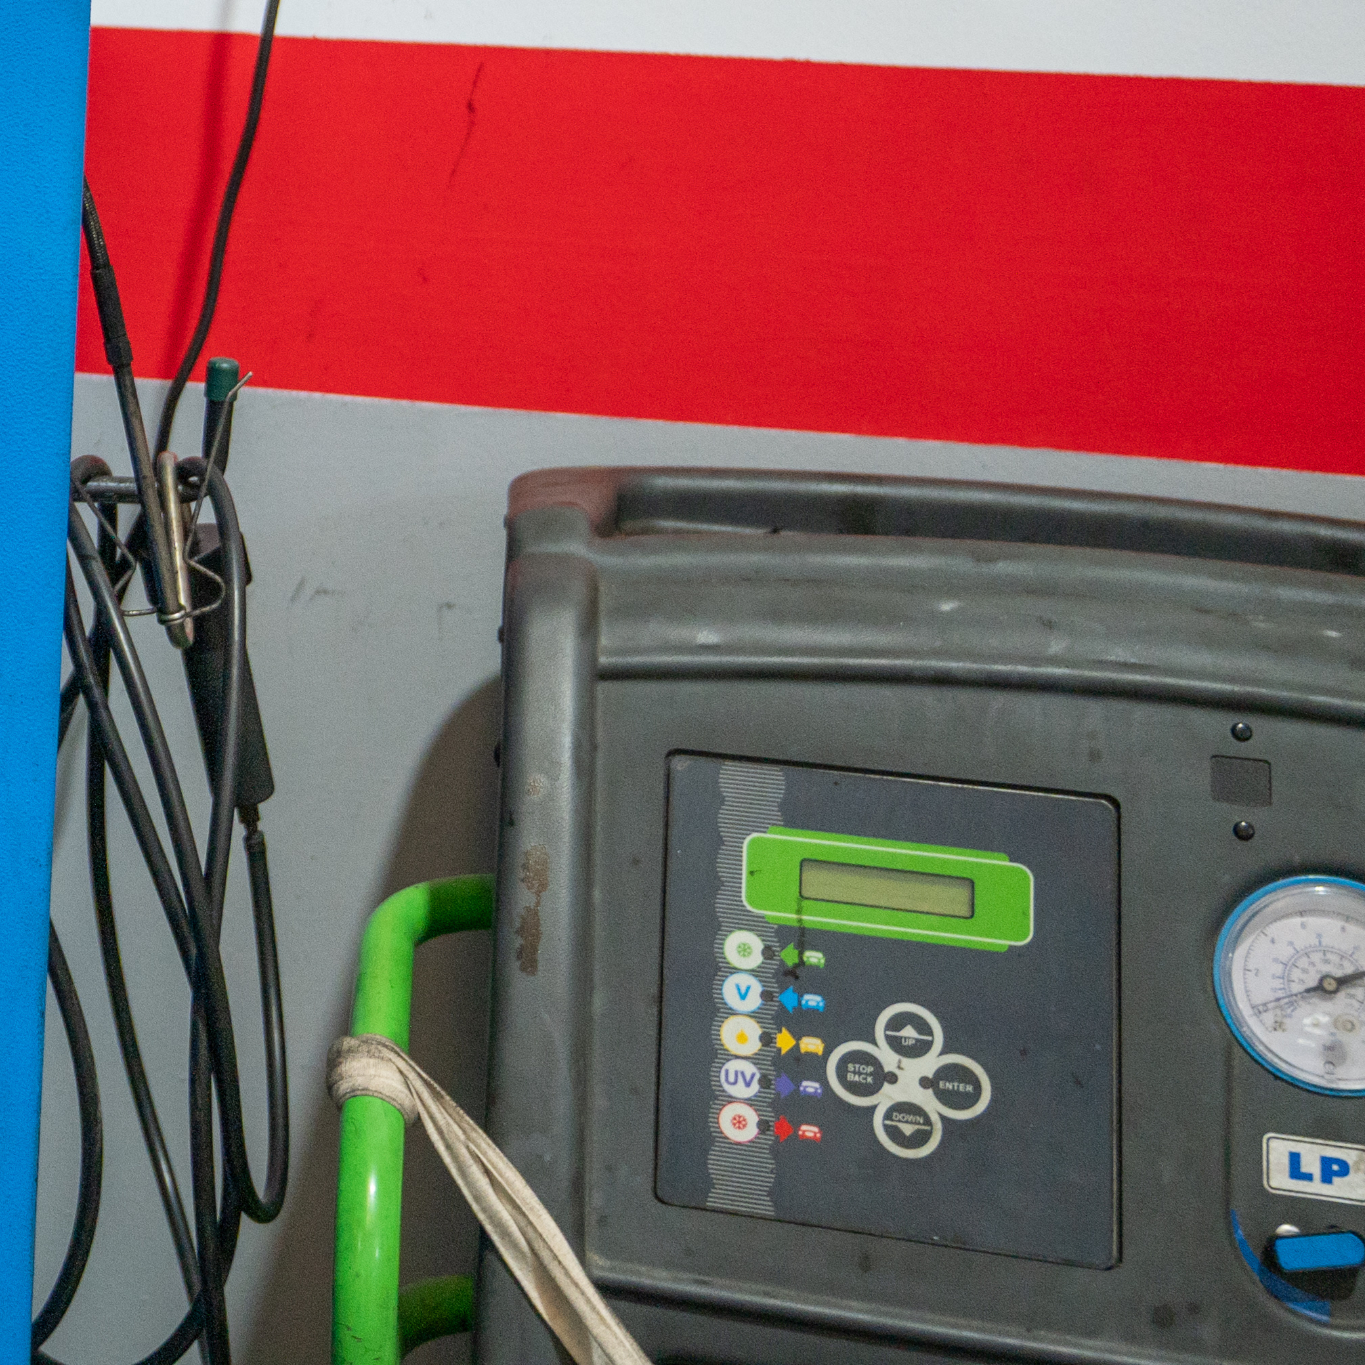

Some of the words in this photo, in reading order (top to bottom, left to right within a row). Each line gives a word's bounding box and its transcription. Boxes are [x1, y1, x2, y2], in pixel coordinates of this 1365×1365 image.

[735, 983, 752, 1002] V
[901, 1037, 916, 1047] UP
[847, 1063, 874, 1075] STOP
[723, 1068, 757, 1089] UV
[846, 1073, 874, 1084] BACK
[938, 1081, 974, 1093] ENTER
[892, 1112, 924, 1124] DOWN
[1288, 1150, 1351, 1185] LP
